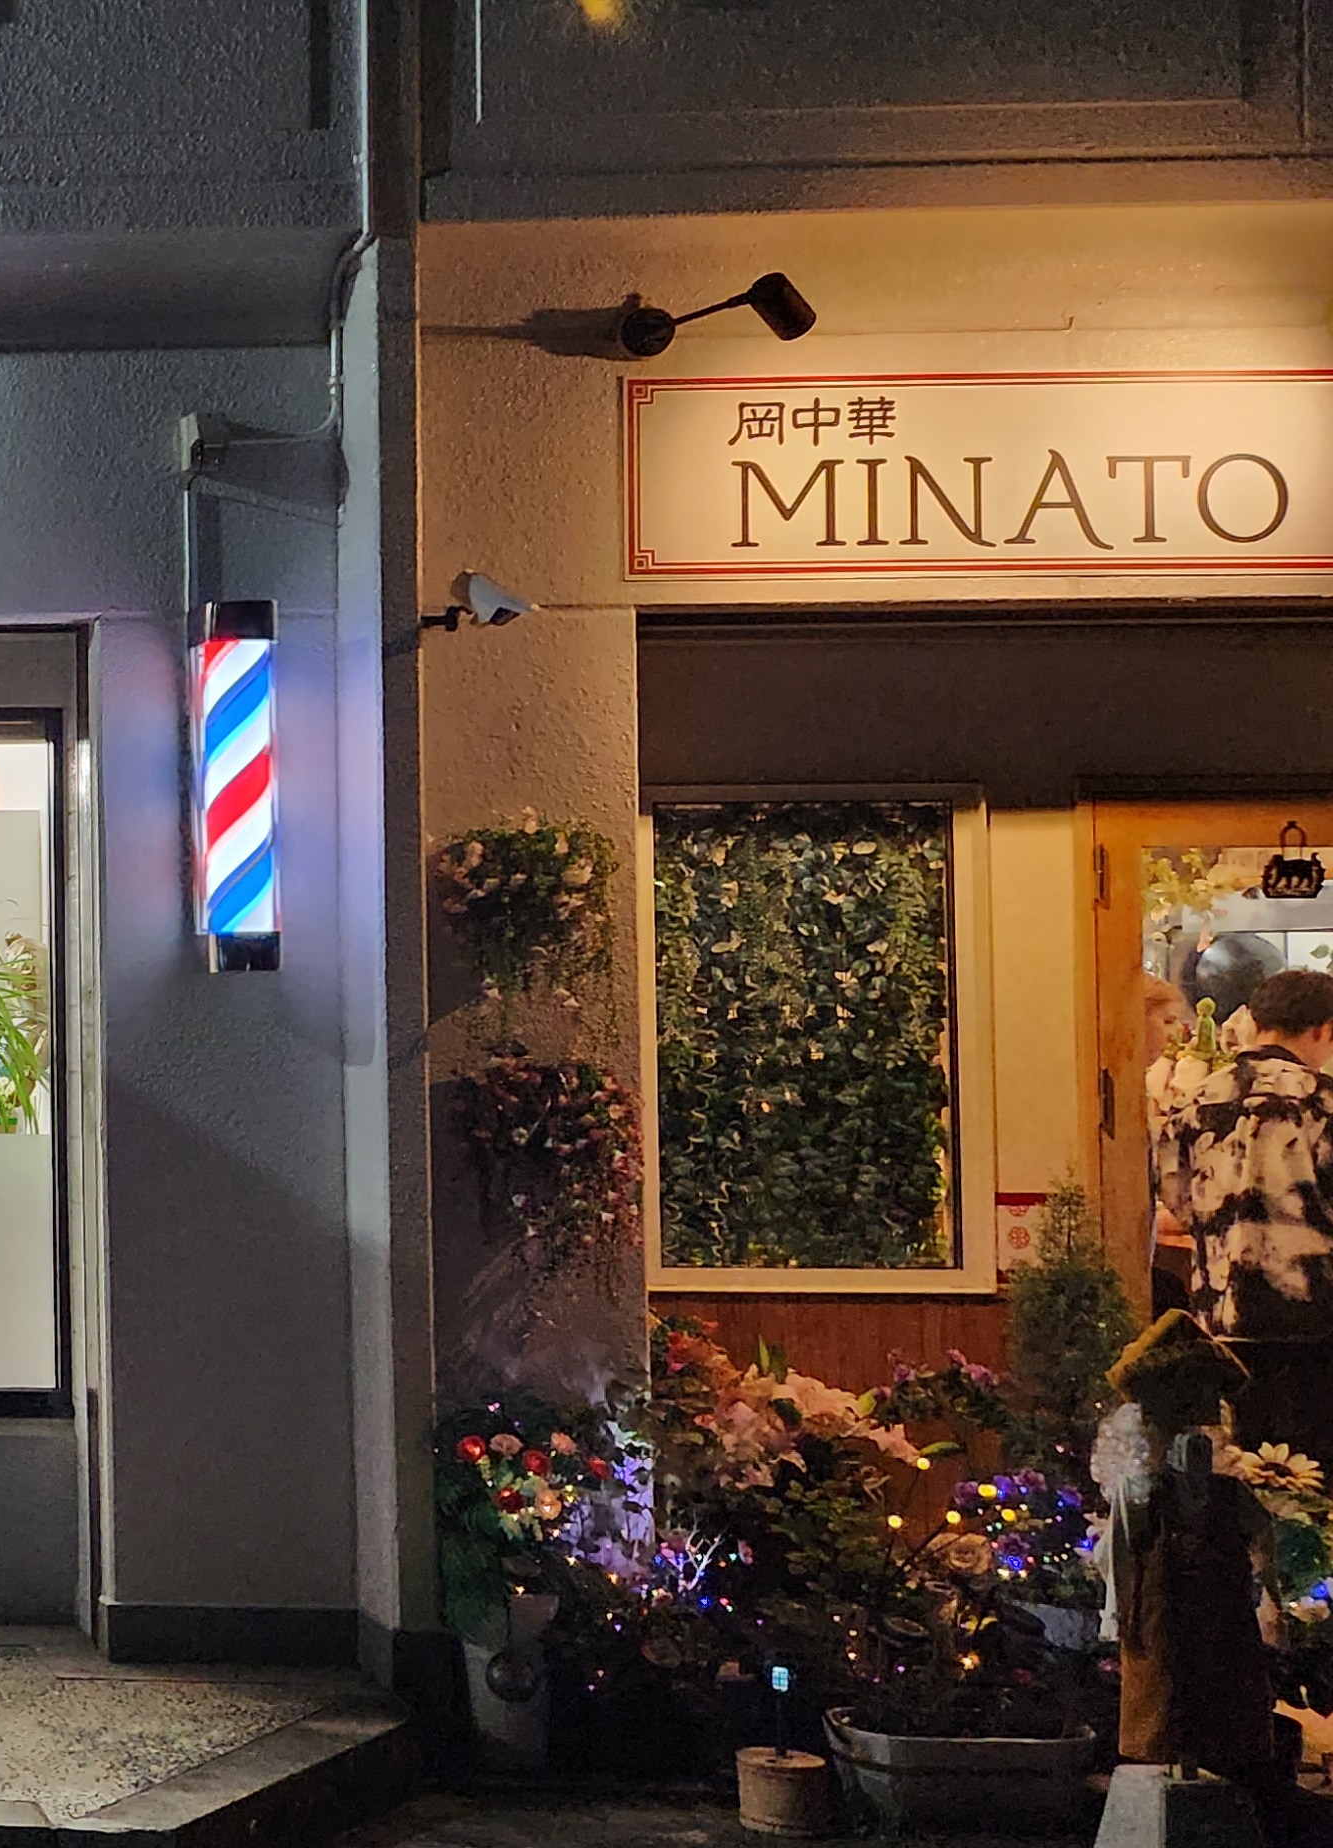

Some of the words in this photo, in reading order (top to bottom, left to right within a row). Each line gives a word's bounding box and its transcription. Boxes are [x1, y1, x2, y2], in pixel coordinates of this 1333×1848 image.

[727, 396, 897, 447] 岡中華
[730, 448, 1290, 551] MINATO
